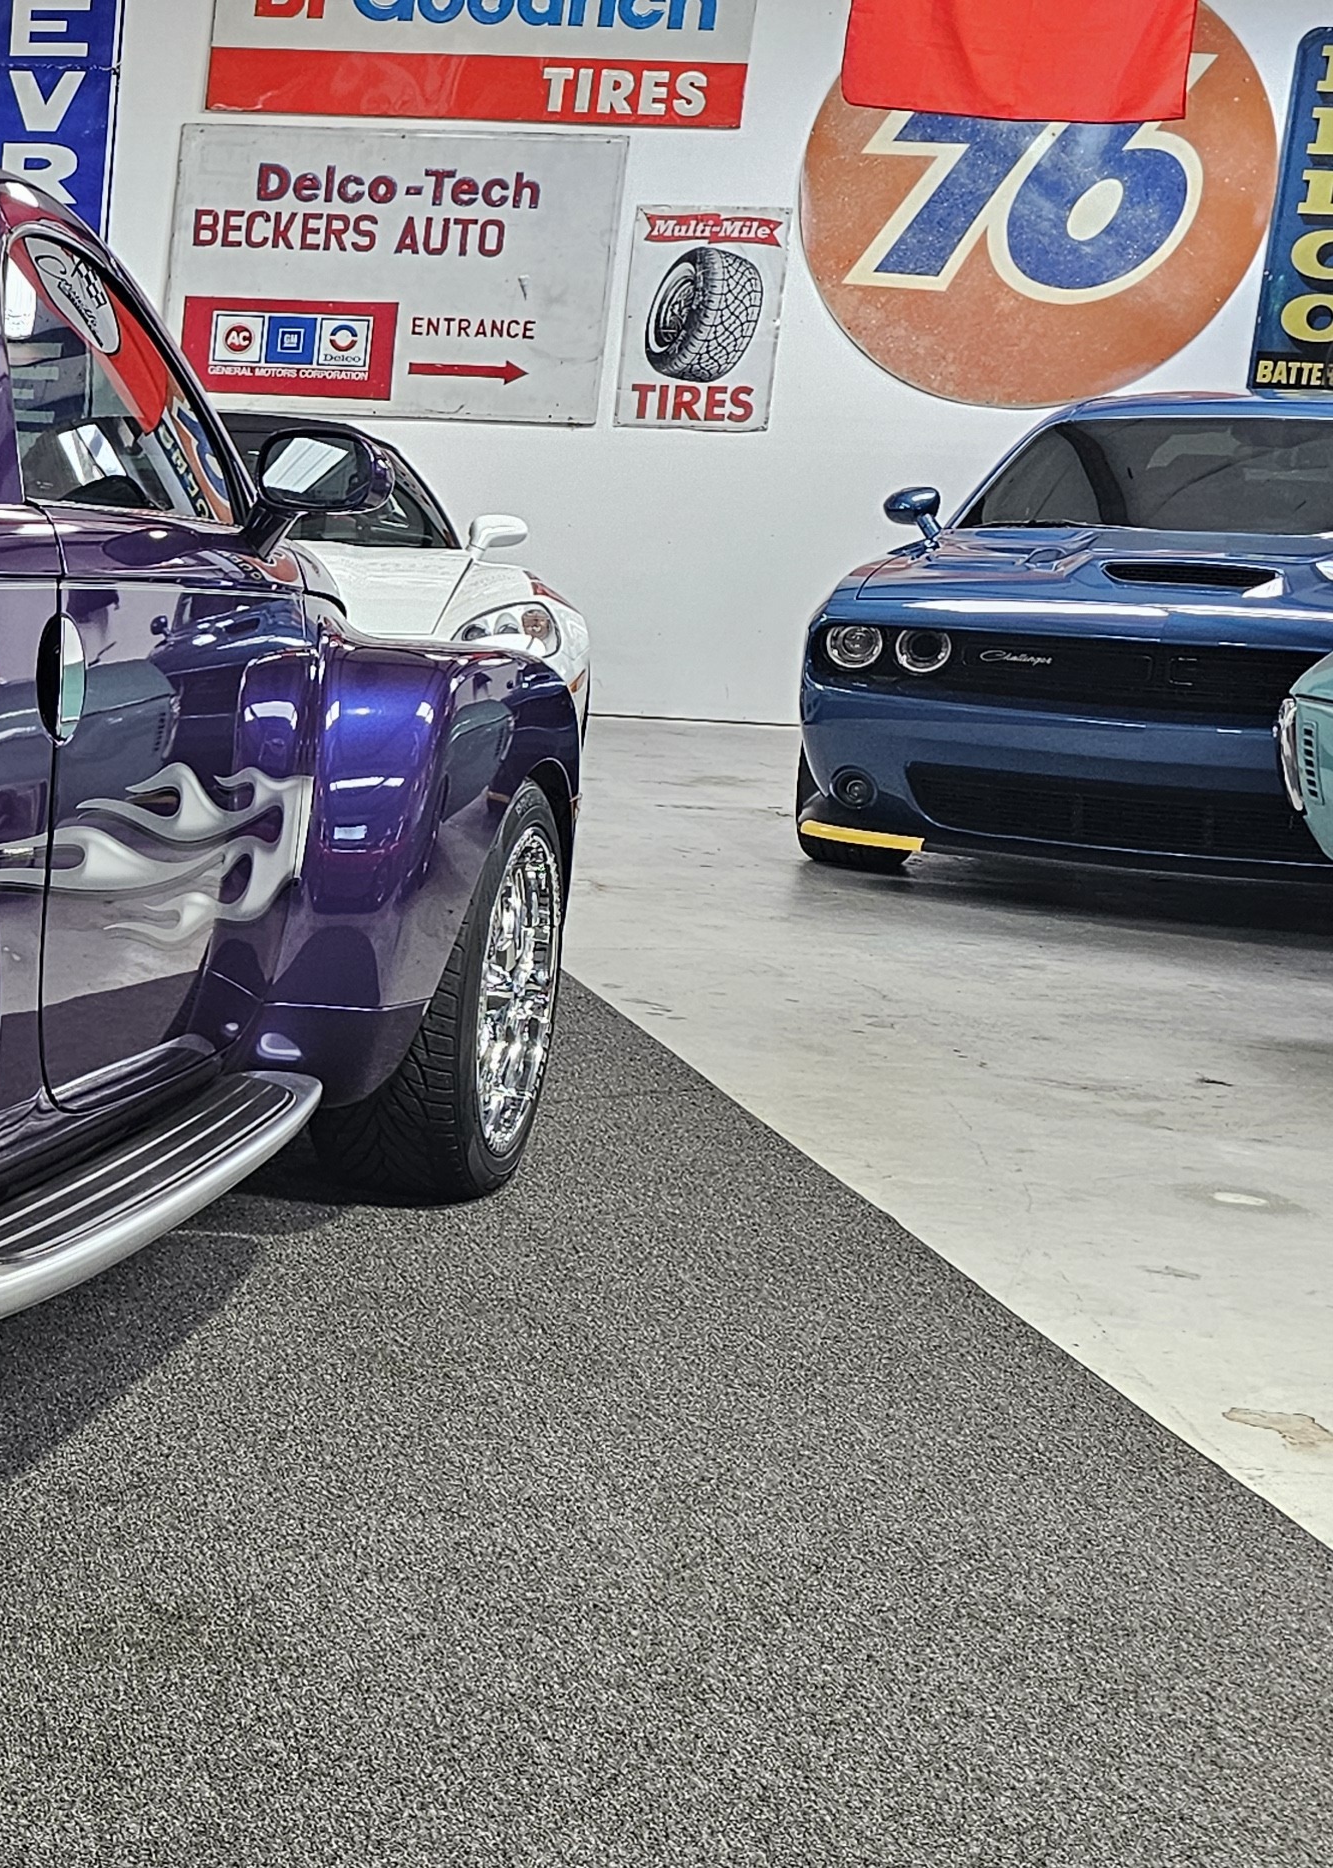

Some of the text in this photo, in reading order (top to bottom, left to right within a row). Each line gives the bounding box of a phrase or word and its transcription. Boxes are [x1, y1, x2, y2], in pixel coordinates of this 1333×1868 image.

[542, 66, 708, 118] TIRES
[256, 162, 541, 209] Delco-Tech
[842, 53, 1218, 305] 76
[192, 208, 506, 258] BECKERS AUTO
[651, 219, 771, 239] Multi-Mile
[226, 330, 250, 347] AC
[283, 333, 298, 345] GM
[411, 316, 536, 340] ENTRANCE
[323, 354, 361, 363] Delco
[208, 366, 368, 381] GENERAL MOTORS CORPORATION
[632, 383, 755, 423] TIRES
